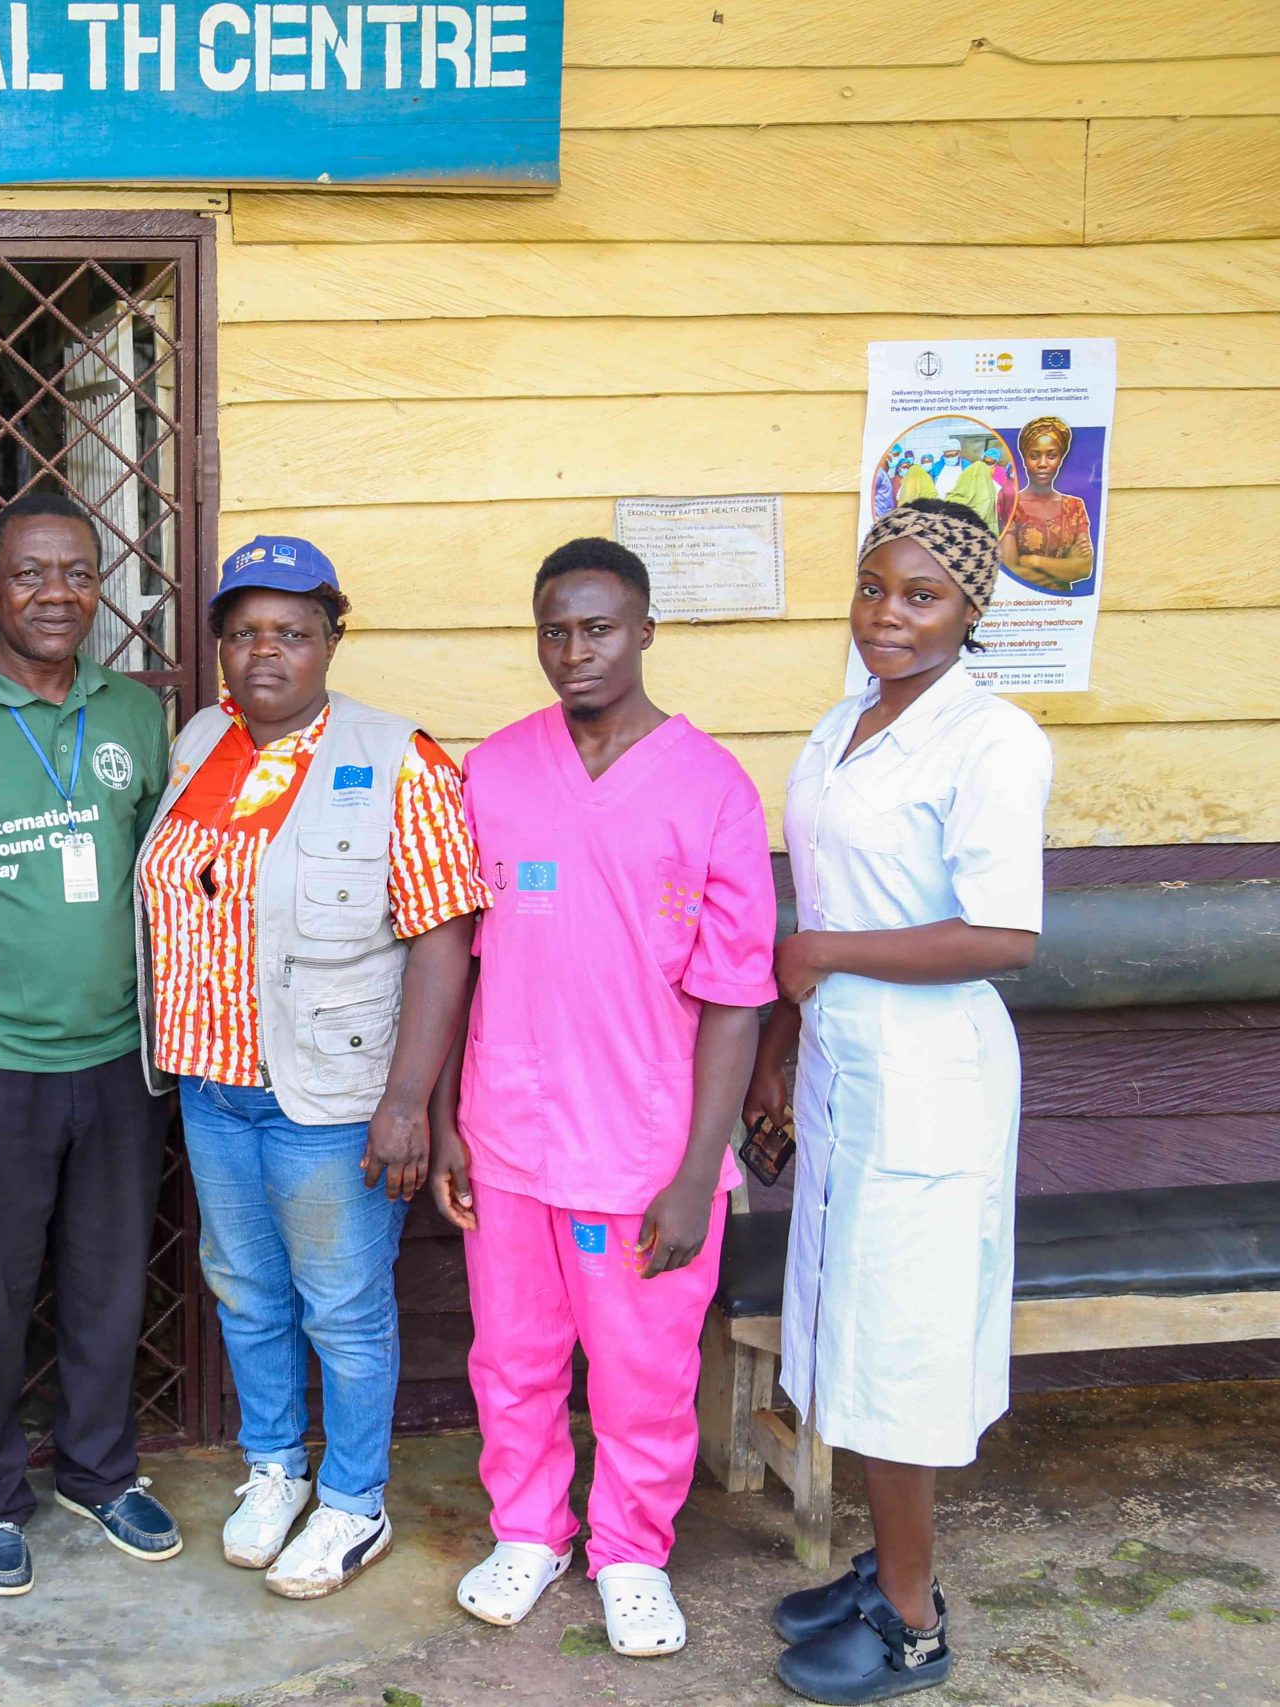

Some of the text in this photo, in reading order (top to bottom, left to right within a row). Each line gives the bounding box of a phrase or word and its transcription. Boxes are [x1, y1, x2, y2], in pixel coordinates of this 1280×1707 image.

[199, 2, 526, 92] CENTRE
[955, 388, 986, 396] integrated
[679, 508, 709, 516] BAPTIST
[987, 600, 1003, 608] elay
[1045, 598, 1072, 607] making
[980, 620, 1001, 629] Delay
[1010, 620, 1042, 628] reaching
[981, 640, 998, 649] elay
[1007, 640, 1040, 648] receiving
[49, 832, 93, 848] Care
